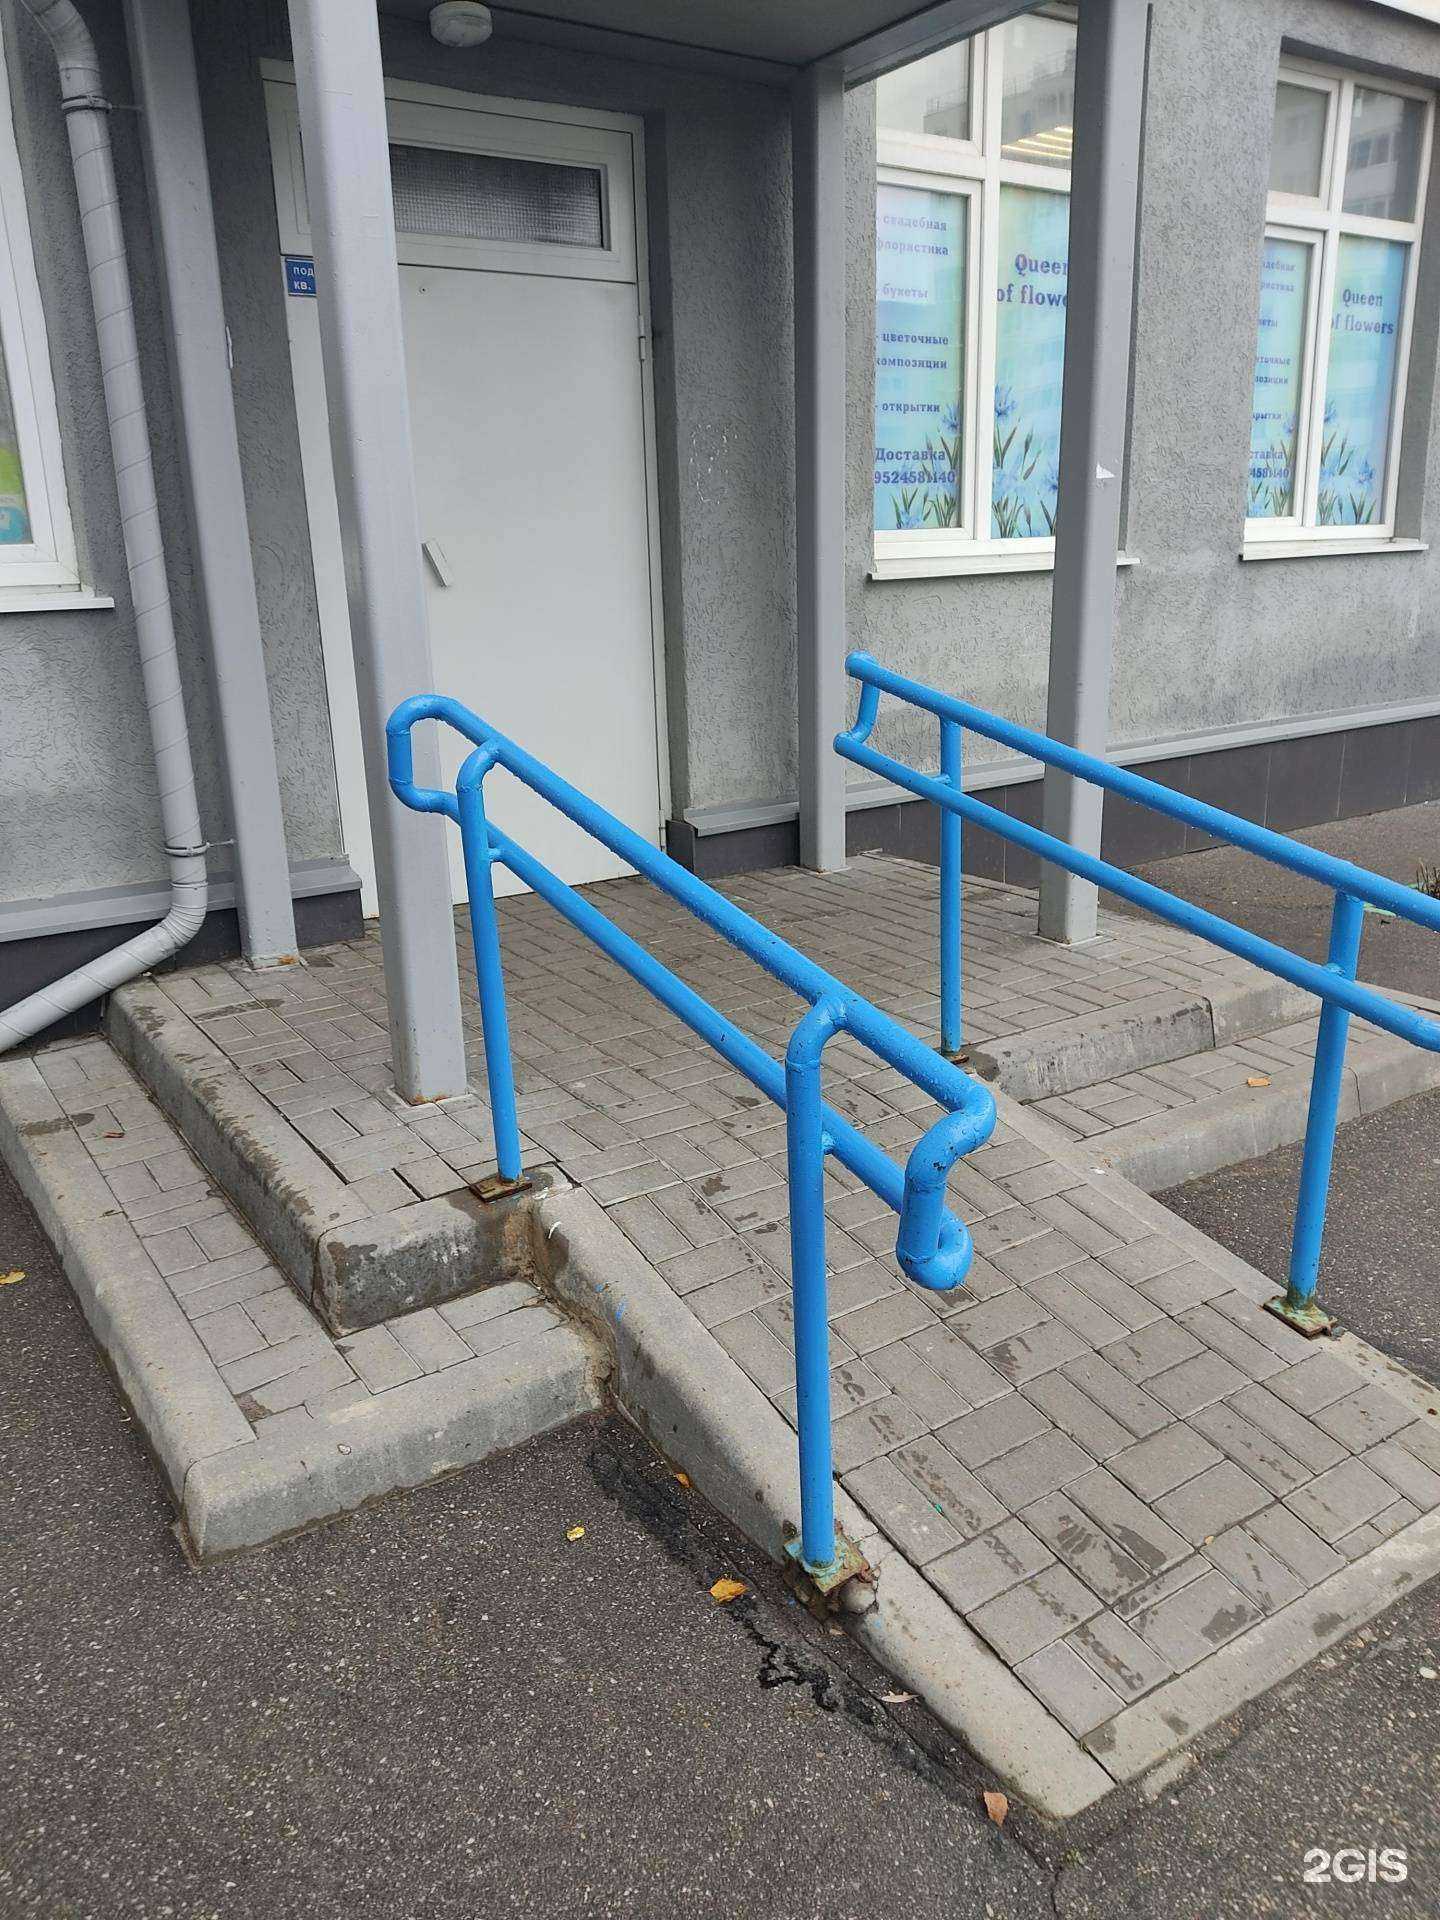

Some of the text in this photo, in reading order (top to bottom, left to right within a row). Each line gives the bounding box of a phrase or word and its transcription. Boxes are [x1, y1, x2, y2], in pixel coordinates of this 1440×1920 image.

[882, 215, 947, 231] свадебная
[881, 282, 928, 299] букеты
[996, 283, 1014, 303] of
[1342, 288, 1383, 308] Queen
[1345, 314, 1395, 335] flowers
[882, 333, 949, 345] цветочные
[881, 402, 940, 414] открытки
[876, 447, 946, 463] Доставка
